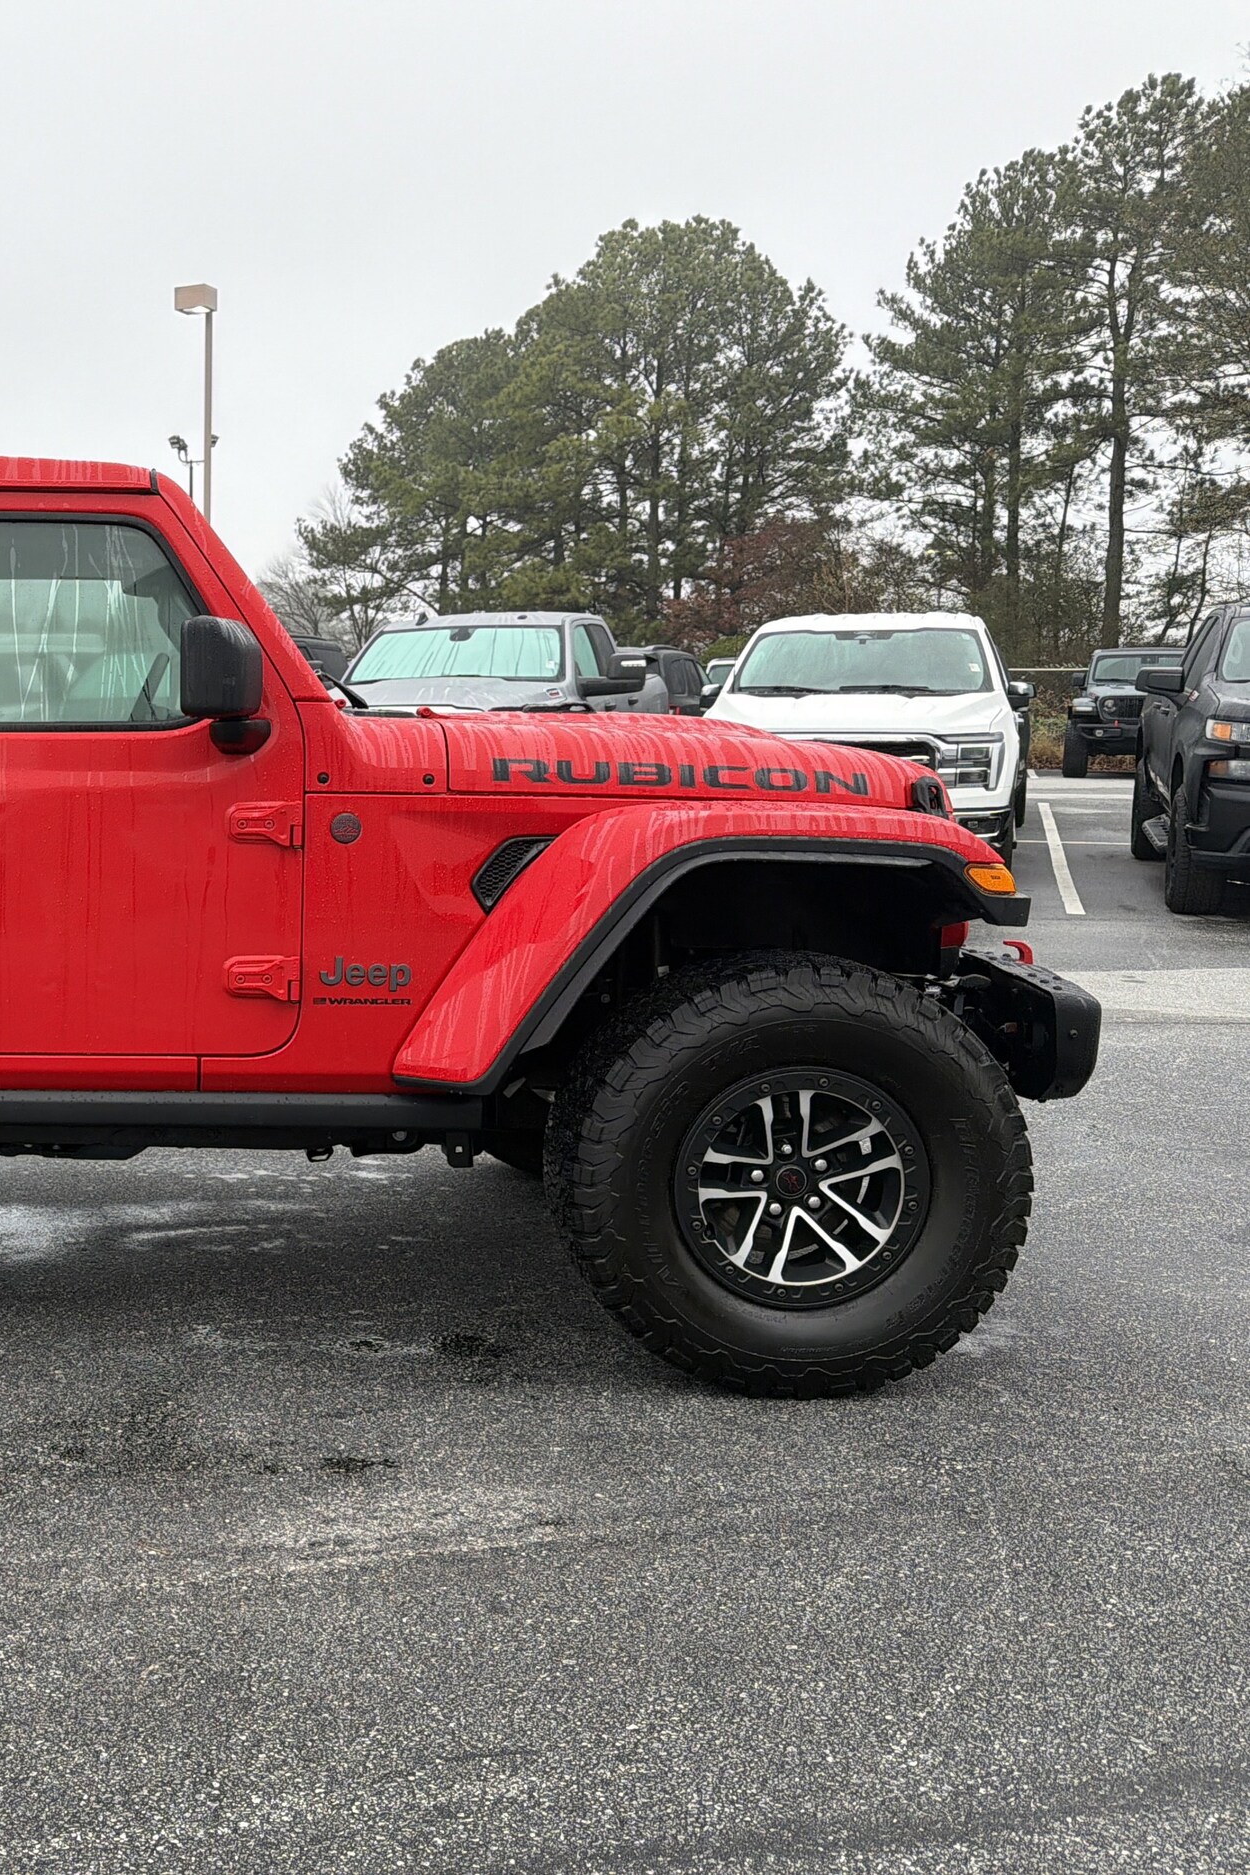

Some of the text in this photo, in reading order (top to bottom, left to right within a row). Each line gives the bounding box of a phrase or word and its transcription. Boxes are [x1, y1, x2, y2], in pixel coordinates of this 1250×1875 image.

[492, 757, 869, 796] RUBICON
[319, 955, 412, 992] Jeep
[327, 997, 412, 1006] WRANGLER
